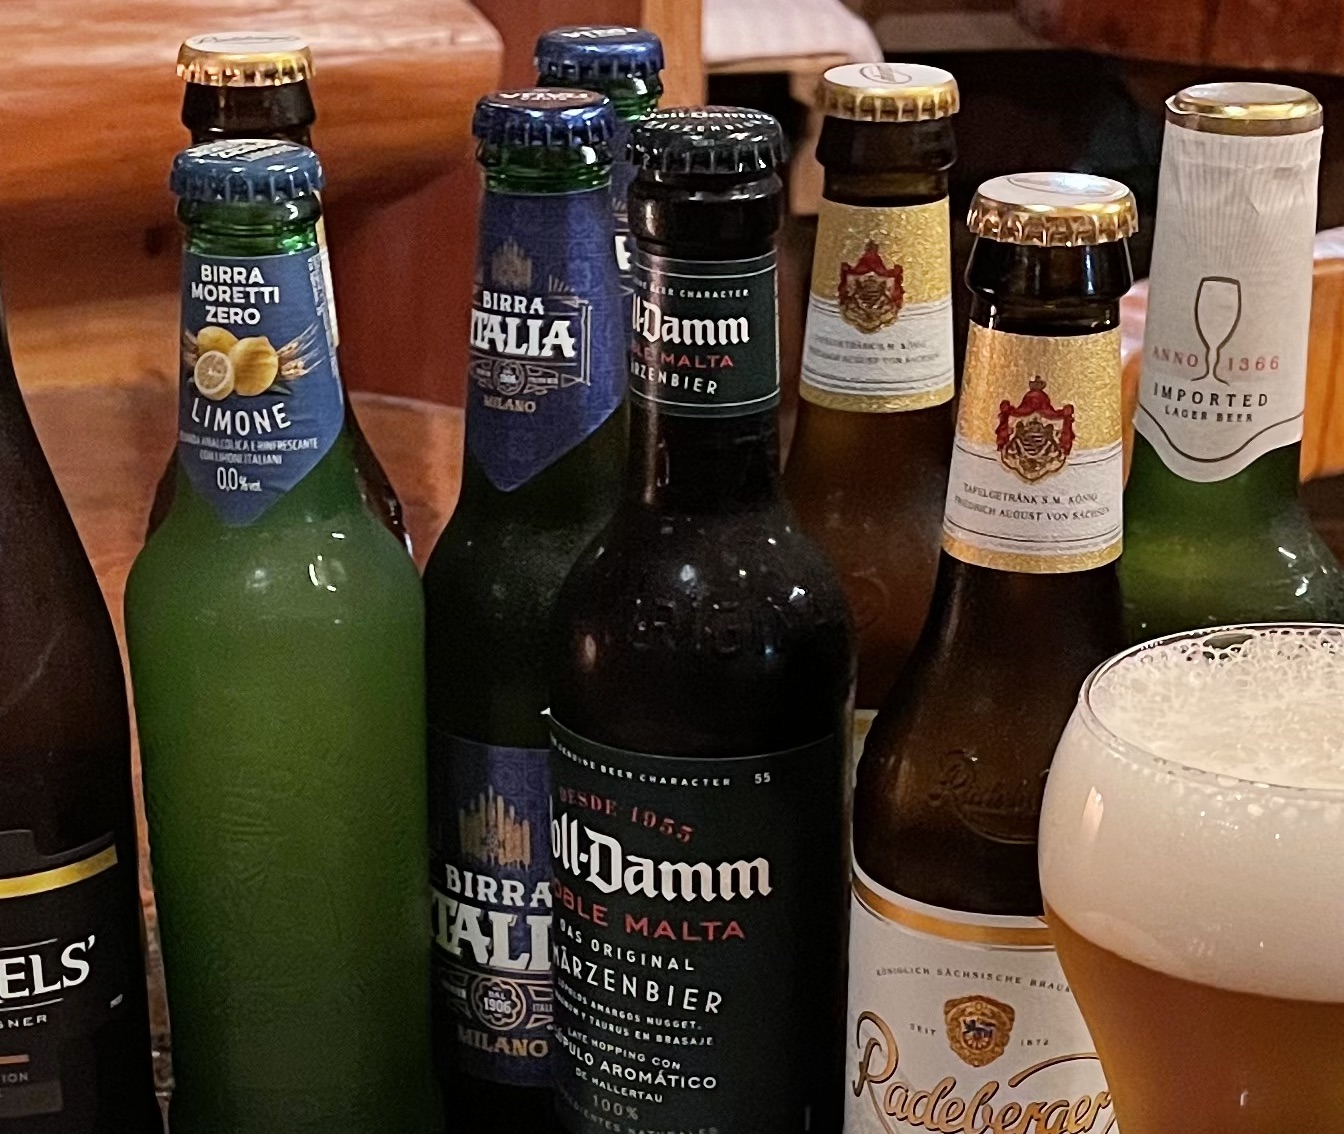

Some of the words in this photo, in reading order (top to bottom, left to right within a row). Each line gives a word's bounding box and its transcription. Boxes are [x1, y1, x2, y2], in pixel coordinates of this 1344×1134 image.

[201, 265, 265, 284] BIRRA
[191, 282, 280, 303] MORETTI
[483, 291, 544, 315] BIRRA
[679, 288, 750, 299] CHARACTER
[205, 305, 261, 325] ZERO
[632, 293, 750, 346] ll-Damm
[661, 353, 734, 369] MALTA
[1153, 346, 1199, 368] ANNO
[1228, 356, 1280, 372] 1366
[631, 361, 718, 395] RZENBIER
[1153, 382, 1268, 407] IMPORTED
[191, 397, 292, 437] LIMONE
[1164, 405, 1208, 421] LAGER
[1216, 411, 1254, 423] BEER
[639, 772, 731, 788] CHARACTER
[754, 772, 772, 784] 55
[559, 786, 617, 816] DESDE
[631, 805, 695, 844] 1955
[550, 795, 773, 902] oll-Damm
[445, 863, 553, 909] BIRRA
[552, 878, 609, 928] OBLE
[624, 912, 745, 941] MALTA
[431, 886, 553, 972] TALI
[560, 917, 583, 945] DAS
[590, 938, 696, 972] ORIGINAL
[936, 967, 1022, 985] SÄCHSISCHE
[484, 998, 512, 1015] 1906
[590, 999, 641, 1024] AMARGOS
[458, 1025, 549, 1058] MILANO
[588, 1014, 630, 1037] TAURUS
[634, 1030, 651, 1042] EN
[656, 1034, 715, 1047] BRASAJE
[909, 1022, 937, 1037] SEIT
[567, 1026, 589, 1045] LATE
[591, 1037, 646, 1063] HOPPING
[651, 1055, 682, 1071] CON
[575, 1066, 589, 1082] DE
[591, 1077, 664, 1103] HALLERTAU
[600, 1059, 718, 1090] AROMÁTICO
[593, 1094, 639, 1121] 100%
